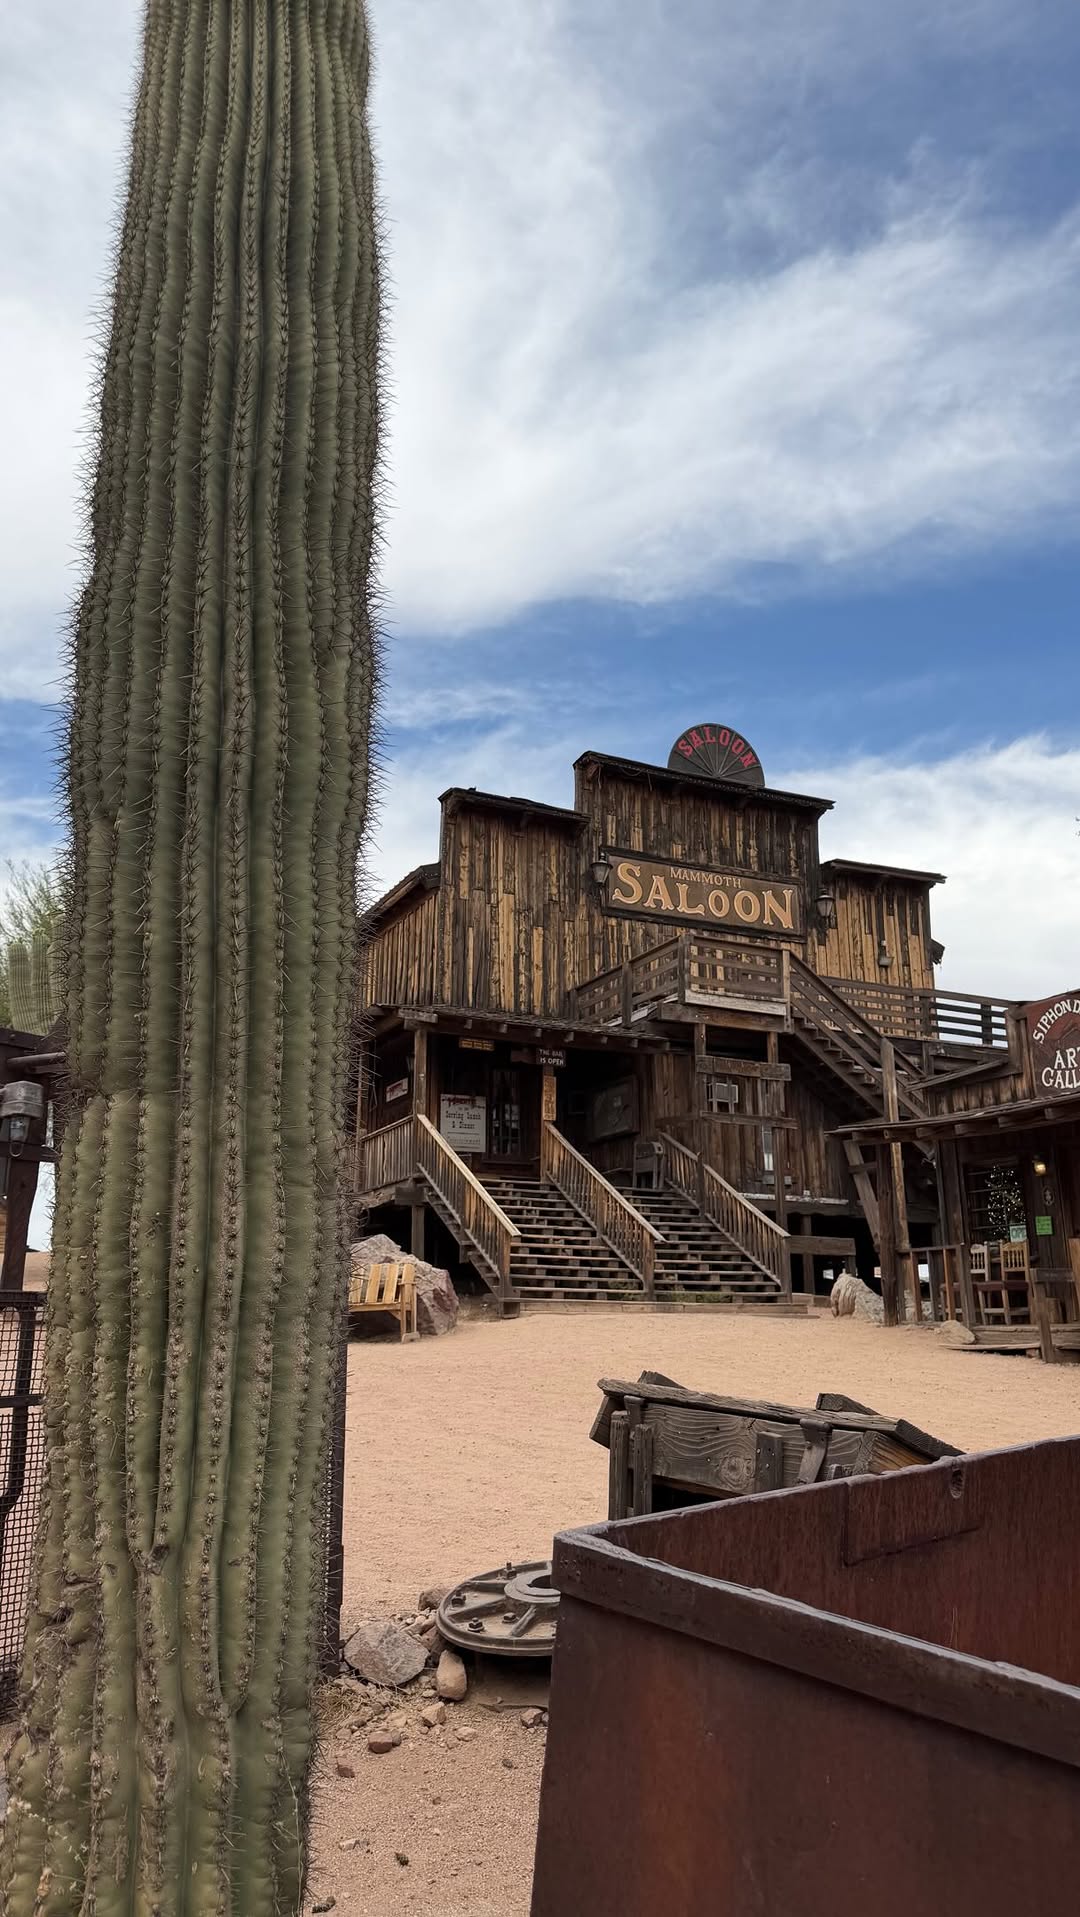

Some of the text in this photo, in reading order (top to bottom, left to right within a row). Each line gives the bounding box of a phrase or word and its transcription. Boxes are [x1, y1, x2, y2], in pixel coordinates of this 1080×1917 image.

[677, 726, 758, 767] SALOON
[670, 867, 741, 888] MAMMOTH
[612, 862, 794, 929] SALOON
[548, 1058, 564, 1066] OPEN
